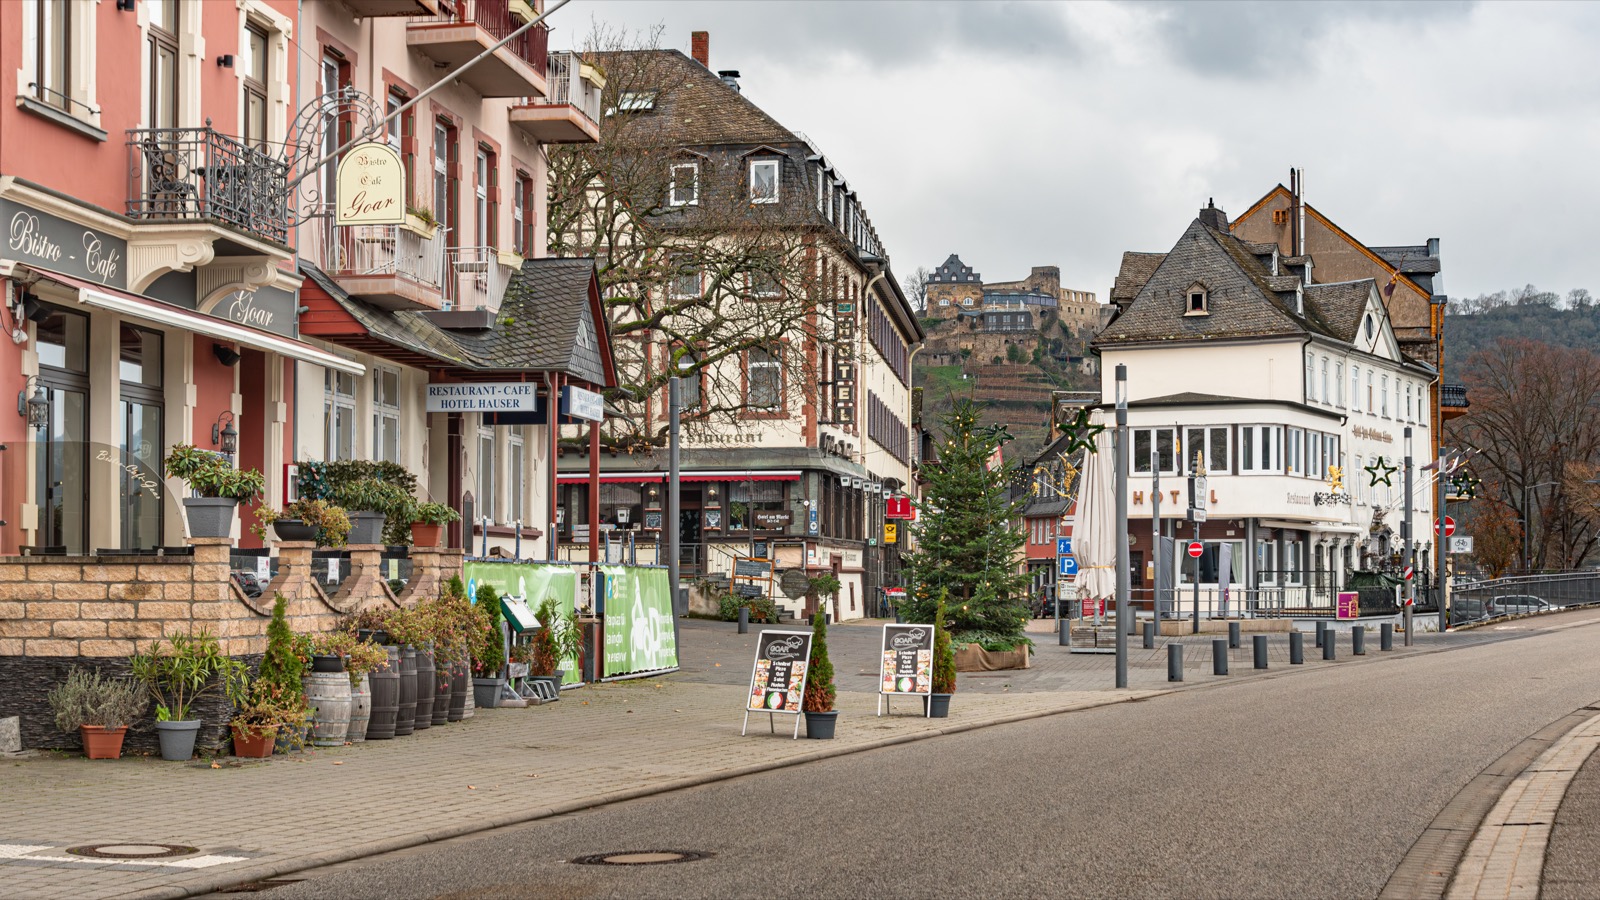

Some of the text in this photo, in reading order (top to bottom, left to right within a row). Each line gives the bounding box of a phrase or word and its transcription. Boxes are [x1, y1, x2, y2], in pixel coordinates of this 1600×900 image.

[357, 155, 387, 166] Bistro
[343, 190, 396, 219] Goar
[9, 210, 62, 262] Bistro
[82, 230, 120, 284] Café
[229, 289, 274, 326] Goar
[838, 321, 851, 422] HOTEL
[429, 385, 497, 397] RESTAURANT
[503, 385, 532, 396] CAFE
[441, 398, 520, 409] HOTEL HAUSER
[679, 431, 763, 444] estaurant
[1133, 489, 1218, 505] HOTL
[1064, 559, 1074, 573] P
[770, 645, 789, 653] GOAR
